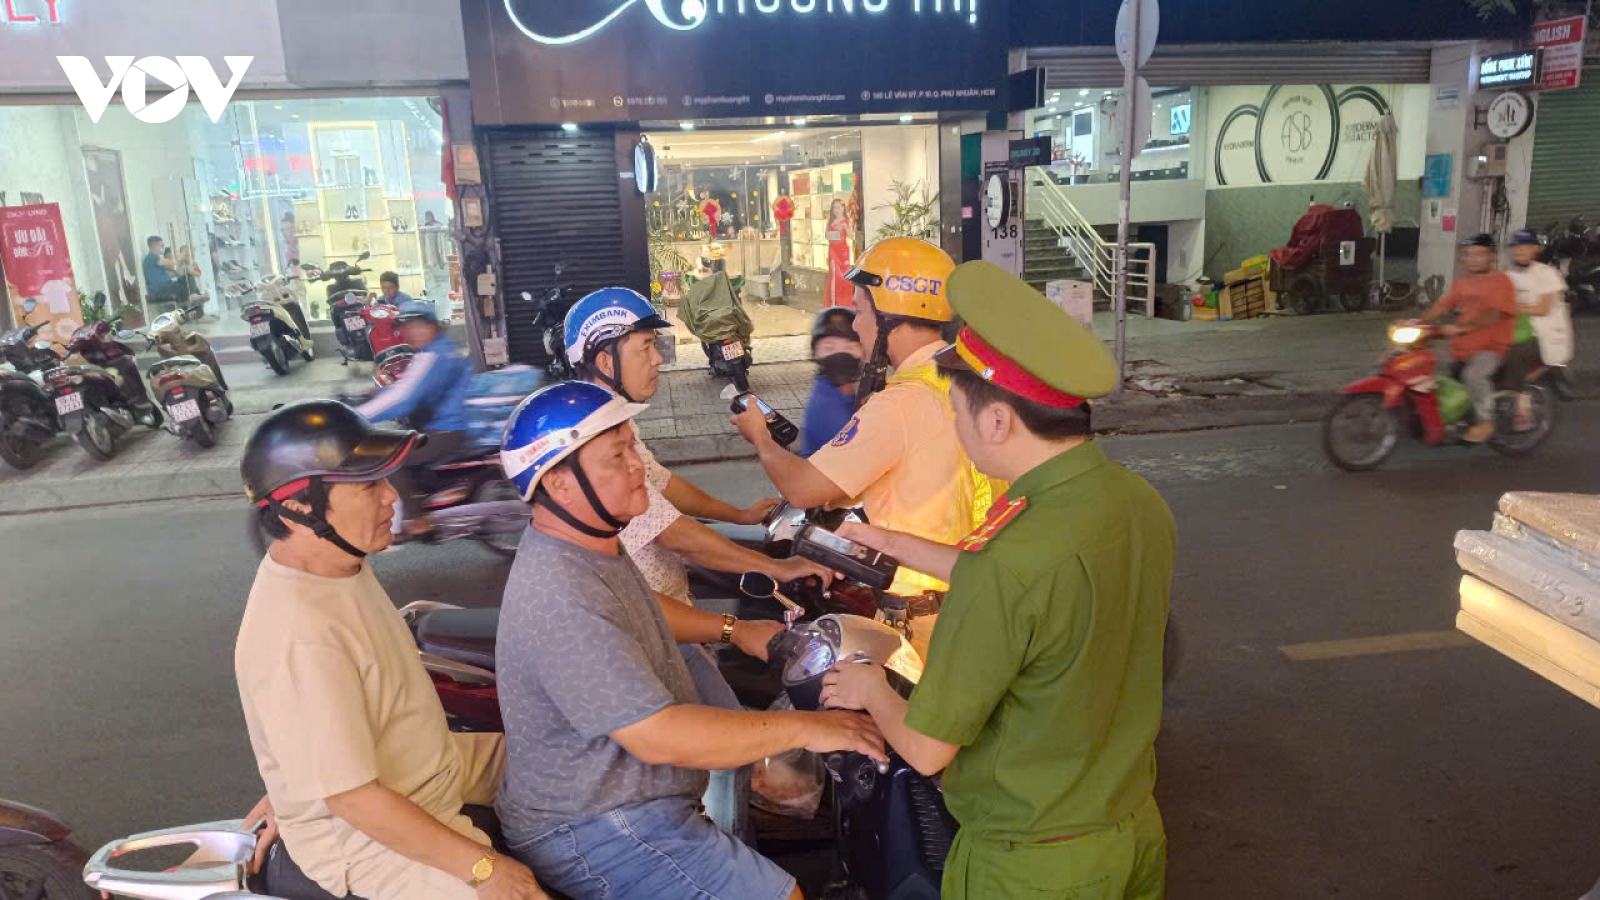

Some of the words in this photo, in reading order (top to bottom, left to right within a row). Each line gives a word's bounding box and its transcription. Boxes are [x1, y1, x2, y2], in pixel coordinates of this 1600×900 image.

[1281, 111, 1312, 153] ASB
[991, 224, 1018, 239] 138
[885, 274, 941, 295] CSGT
[581, 309, 628, 337] EXIMBANK
